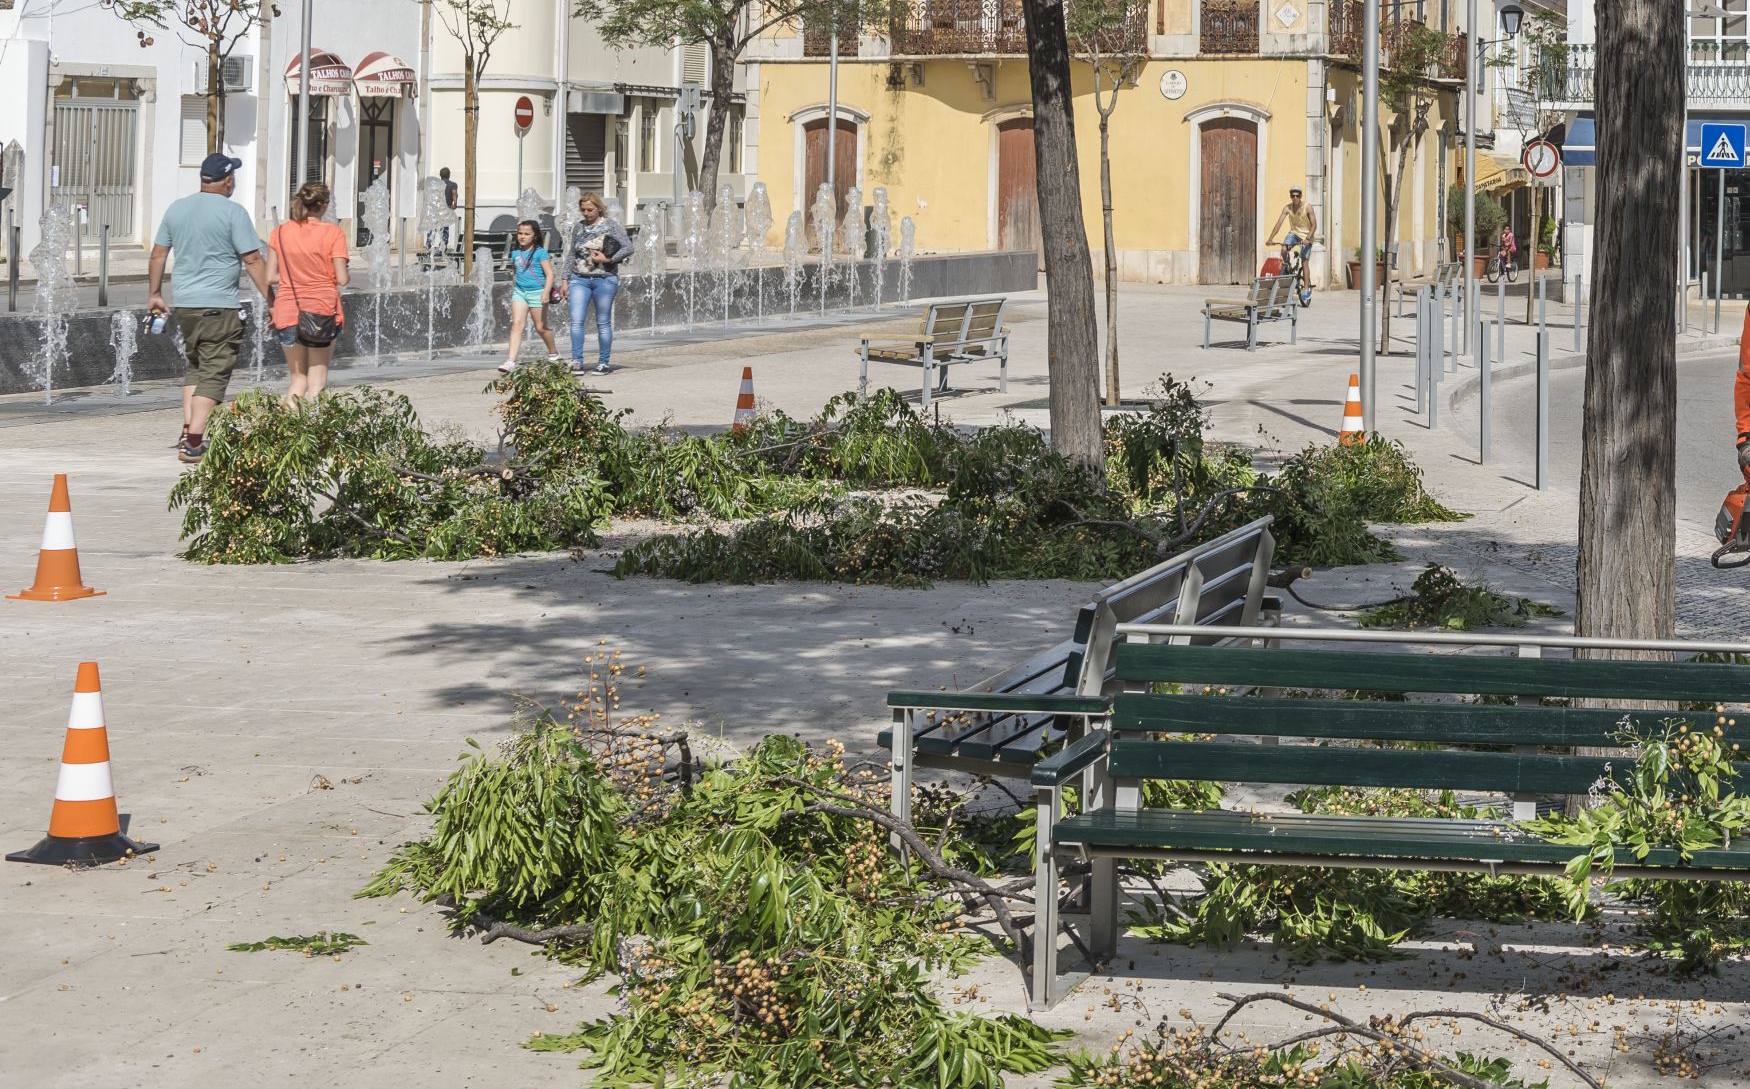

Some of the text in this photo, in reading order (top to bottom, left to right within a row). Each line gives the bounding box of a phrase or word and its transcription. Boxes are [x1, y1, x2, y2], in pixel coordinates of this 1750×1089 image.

[311, 69, 339, 80] TALHOS
[378, 71, 404, 81] TALHOS
[366, 85, 385, 93] Talho
